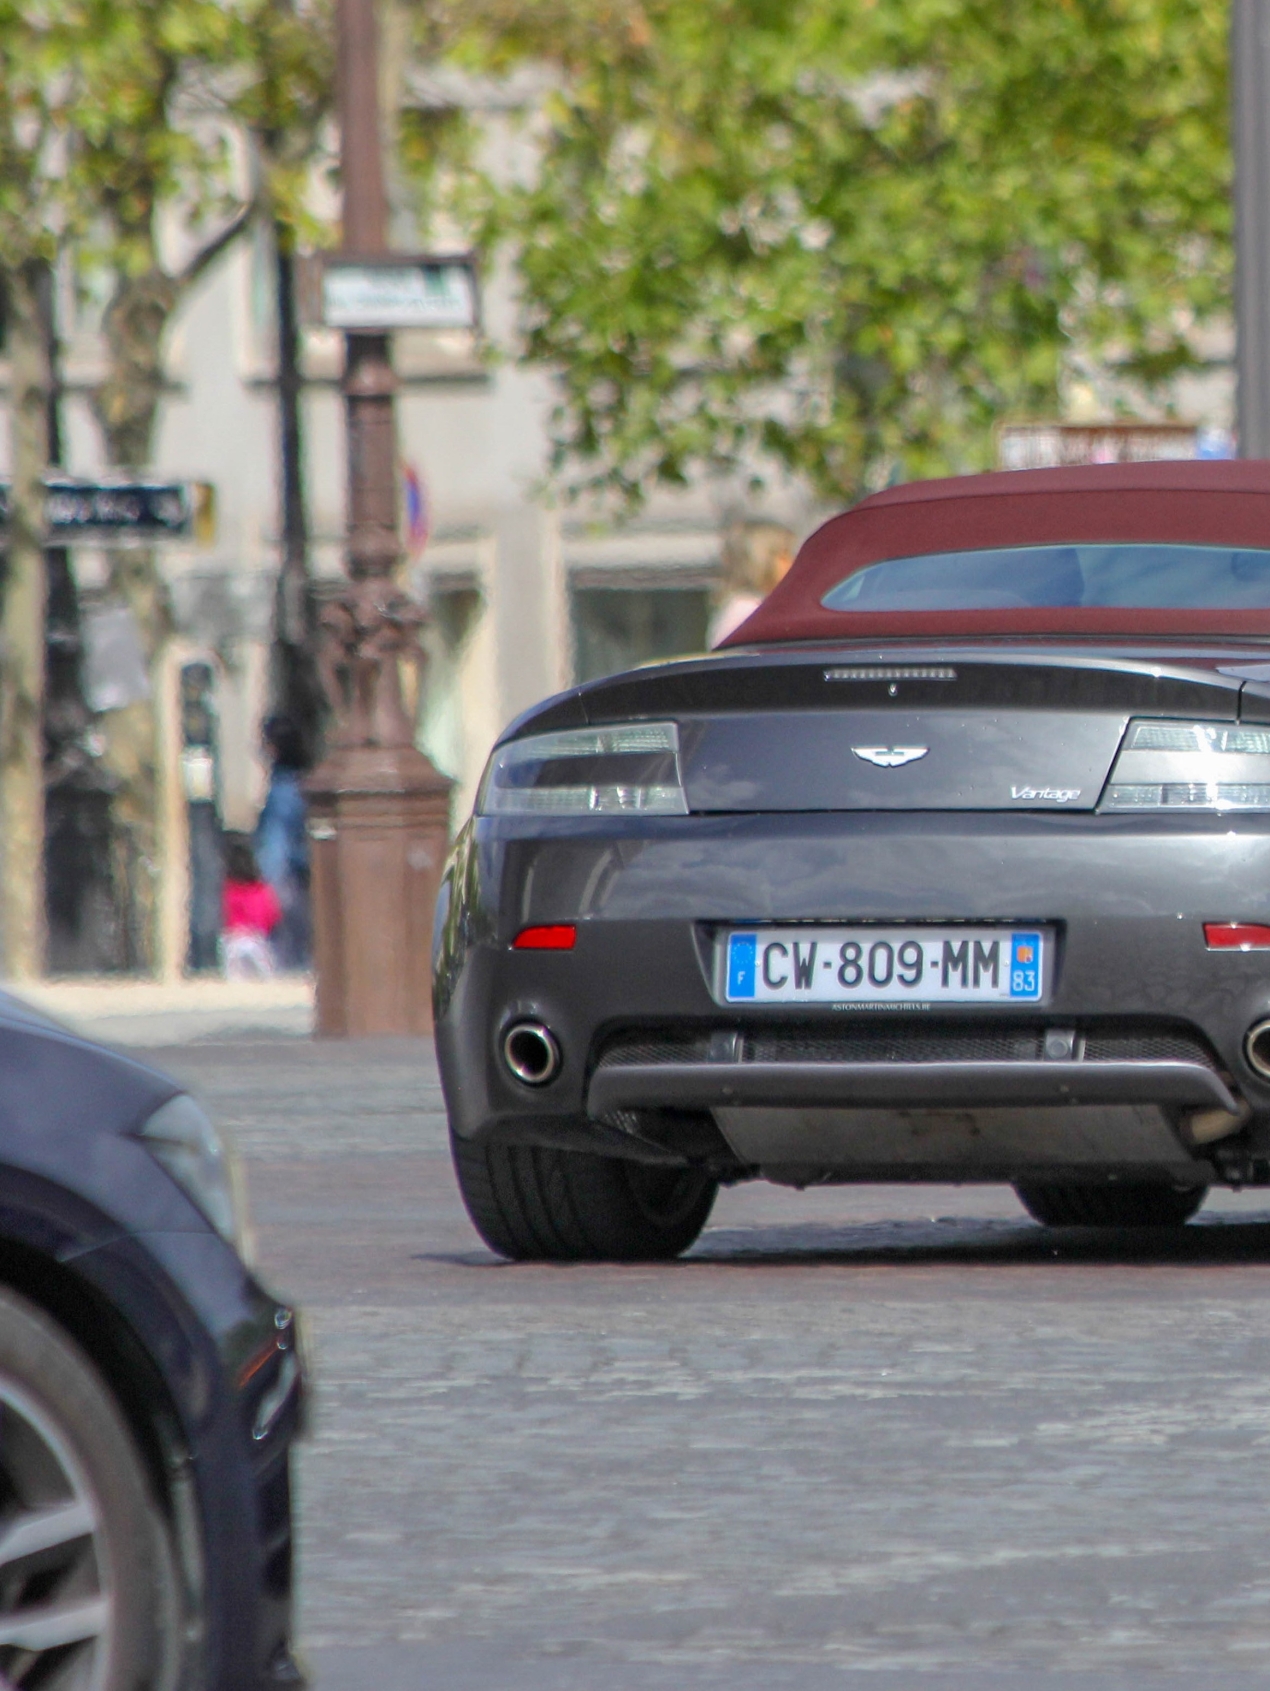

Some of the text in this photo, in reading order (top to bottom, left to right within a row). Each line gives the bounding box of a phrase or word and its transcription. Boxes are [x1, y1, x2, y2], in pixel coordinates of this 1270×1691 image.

[1010, 786, 1081, 802] Vantage
[762, 941, 999, 989] CW-809-MM
[737, 971, 745, 985] F
[1012, 971, 1035, 991] 83
